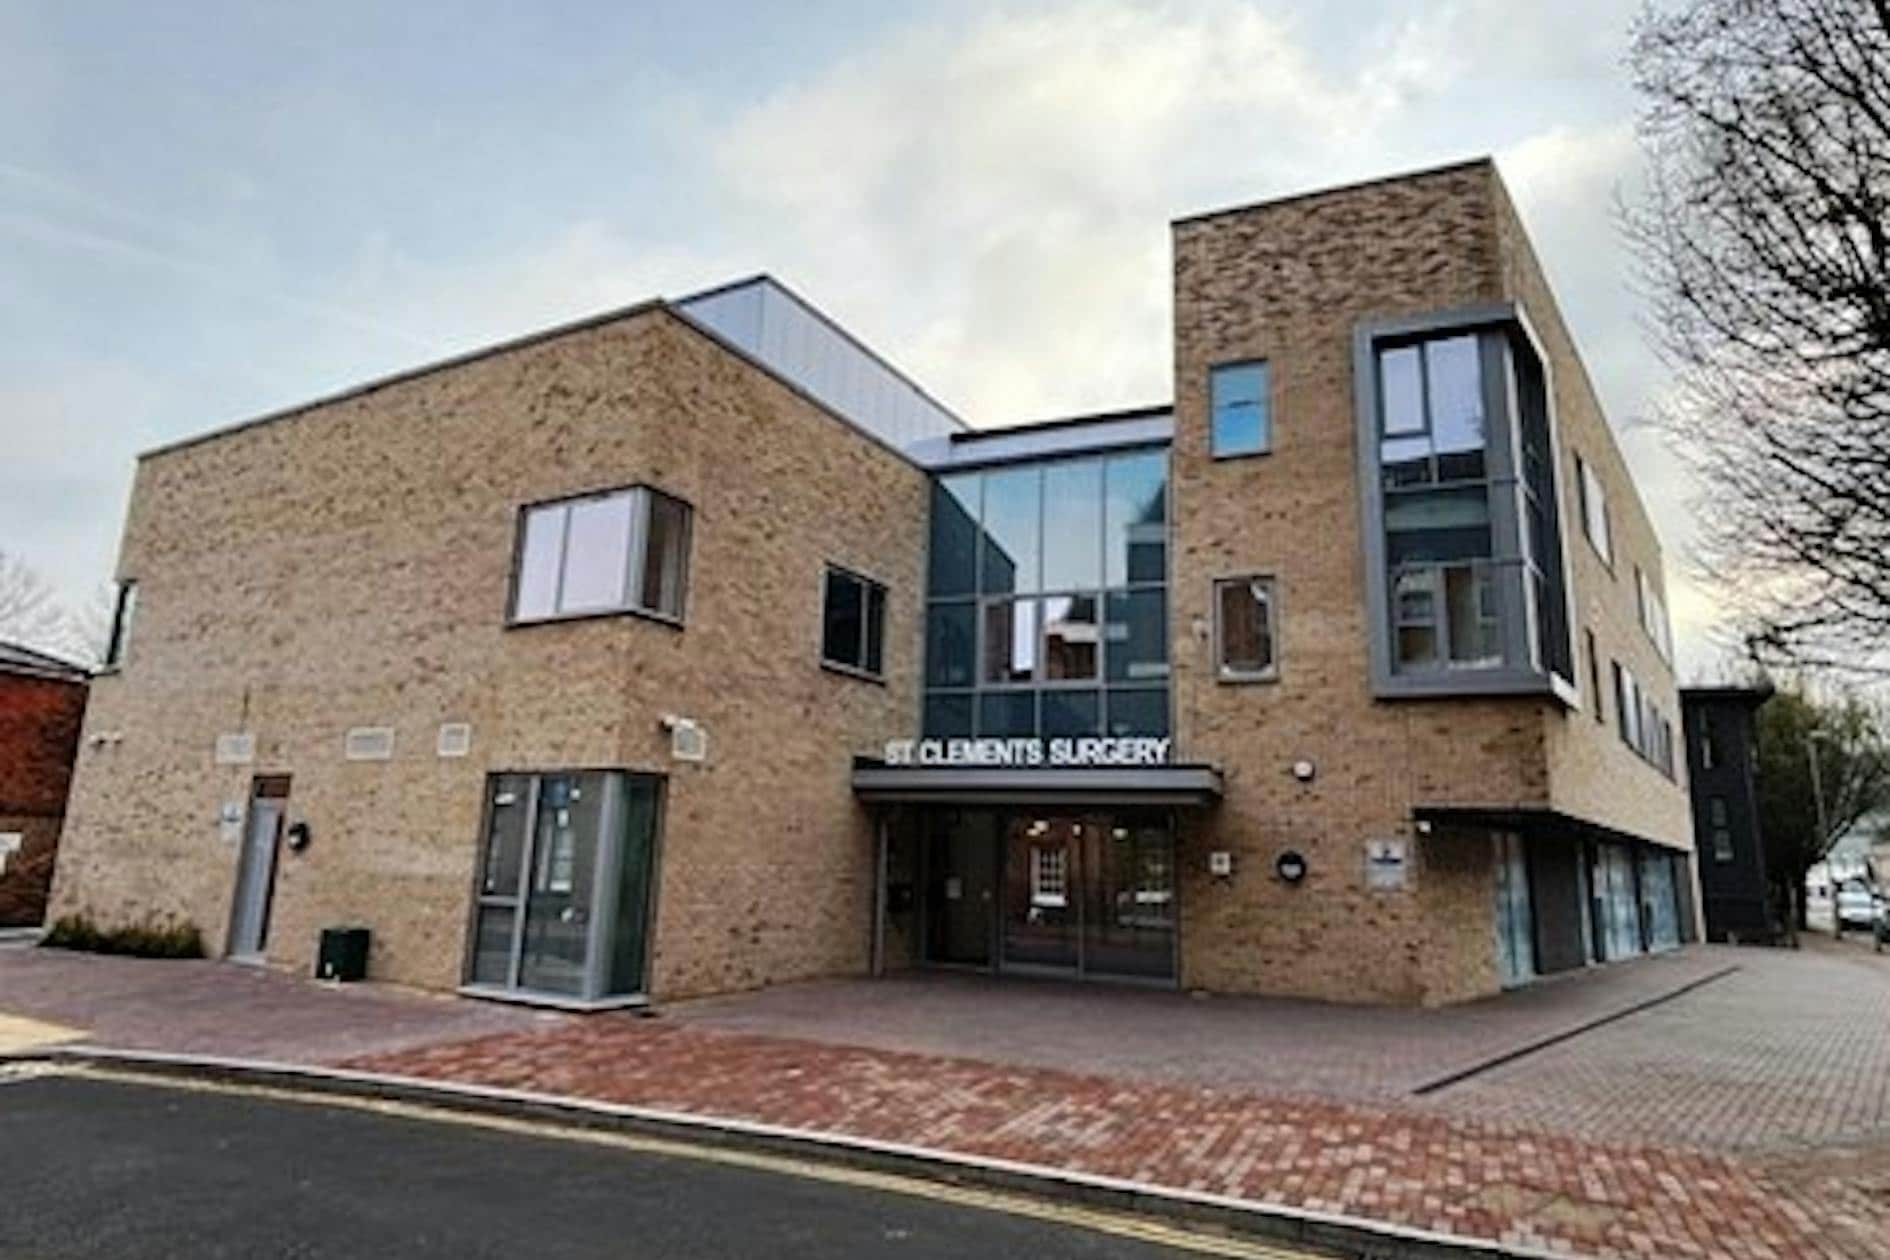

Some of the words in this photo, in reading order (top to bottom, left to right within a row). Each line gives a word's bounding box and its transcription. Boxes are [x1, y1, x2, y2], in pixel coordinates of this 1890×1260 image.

[885, 739, 915, 765] ST
[920, 738, 1043, 765] CLEMENTS
[1050, 738, 1170, 765] SURGERY
